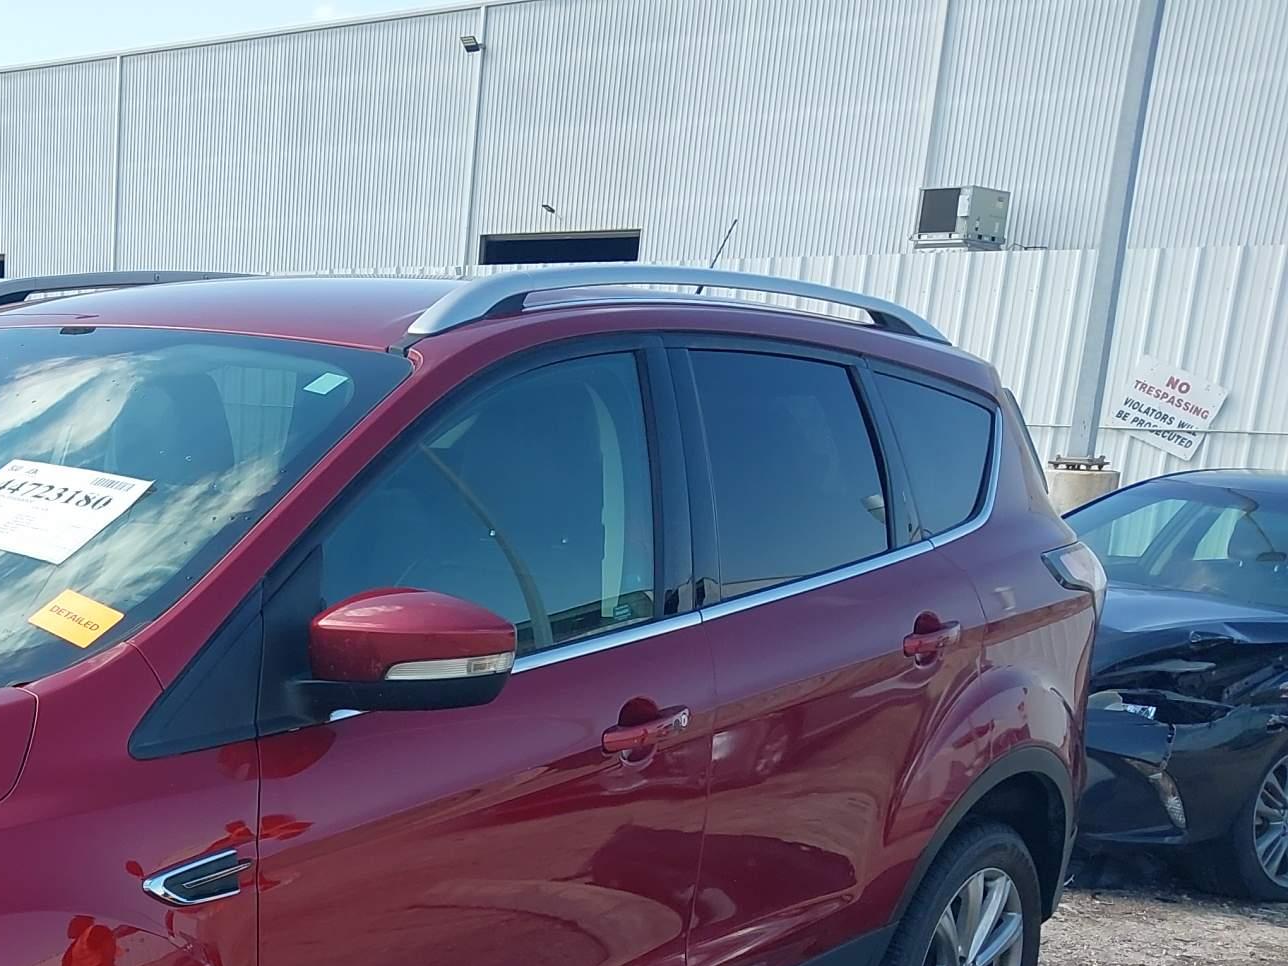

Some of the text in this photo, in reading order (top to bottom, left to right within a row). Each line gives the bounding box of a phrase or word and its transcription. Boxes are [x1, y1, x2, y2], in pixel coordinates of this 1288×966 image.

[1165, 375, 1191, 394] NO
[1123, 397, 1176, 425] VIOLATORS
[1133, 379, 1210, 420] TRESPASSING
[1115, 409, 1130, 422] BE
[49, 604, 100, 632] DETAILED
